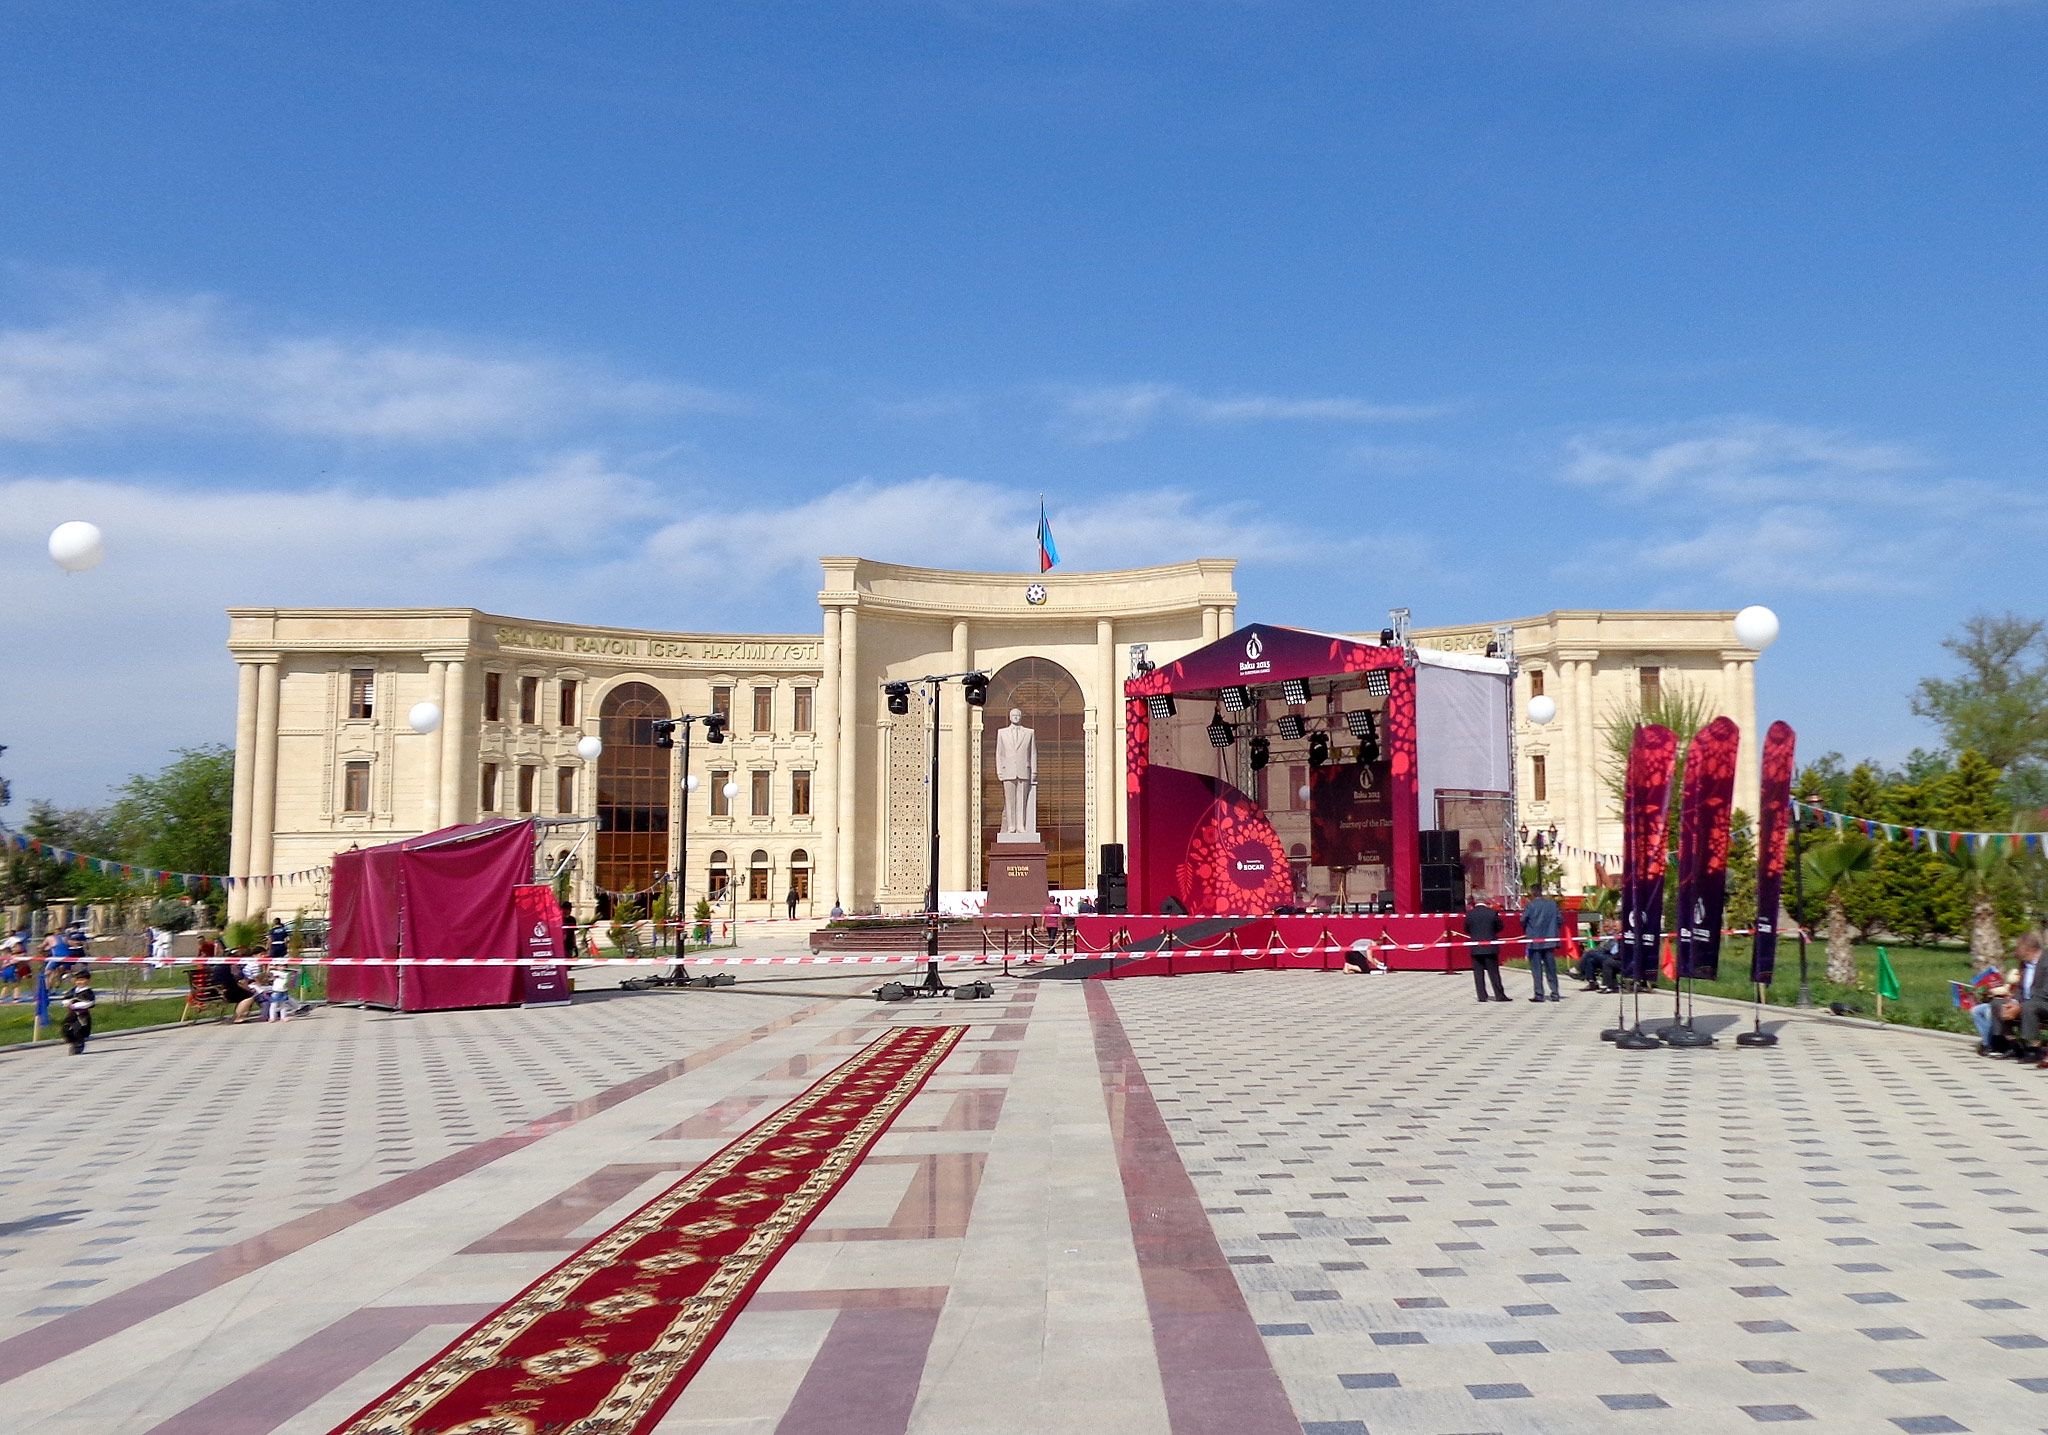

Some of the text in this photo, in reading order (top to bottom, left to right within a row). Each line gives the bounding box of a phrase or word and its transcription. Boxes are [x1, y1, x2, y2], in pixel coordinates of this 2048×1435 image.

[499, 628, 819, 660] SALYAN RAYON İCRA HAKİMİYYƏTİ
